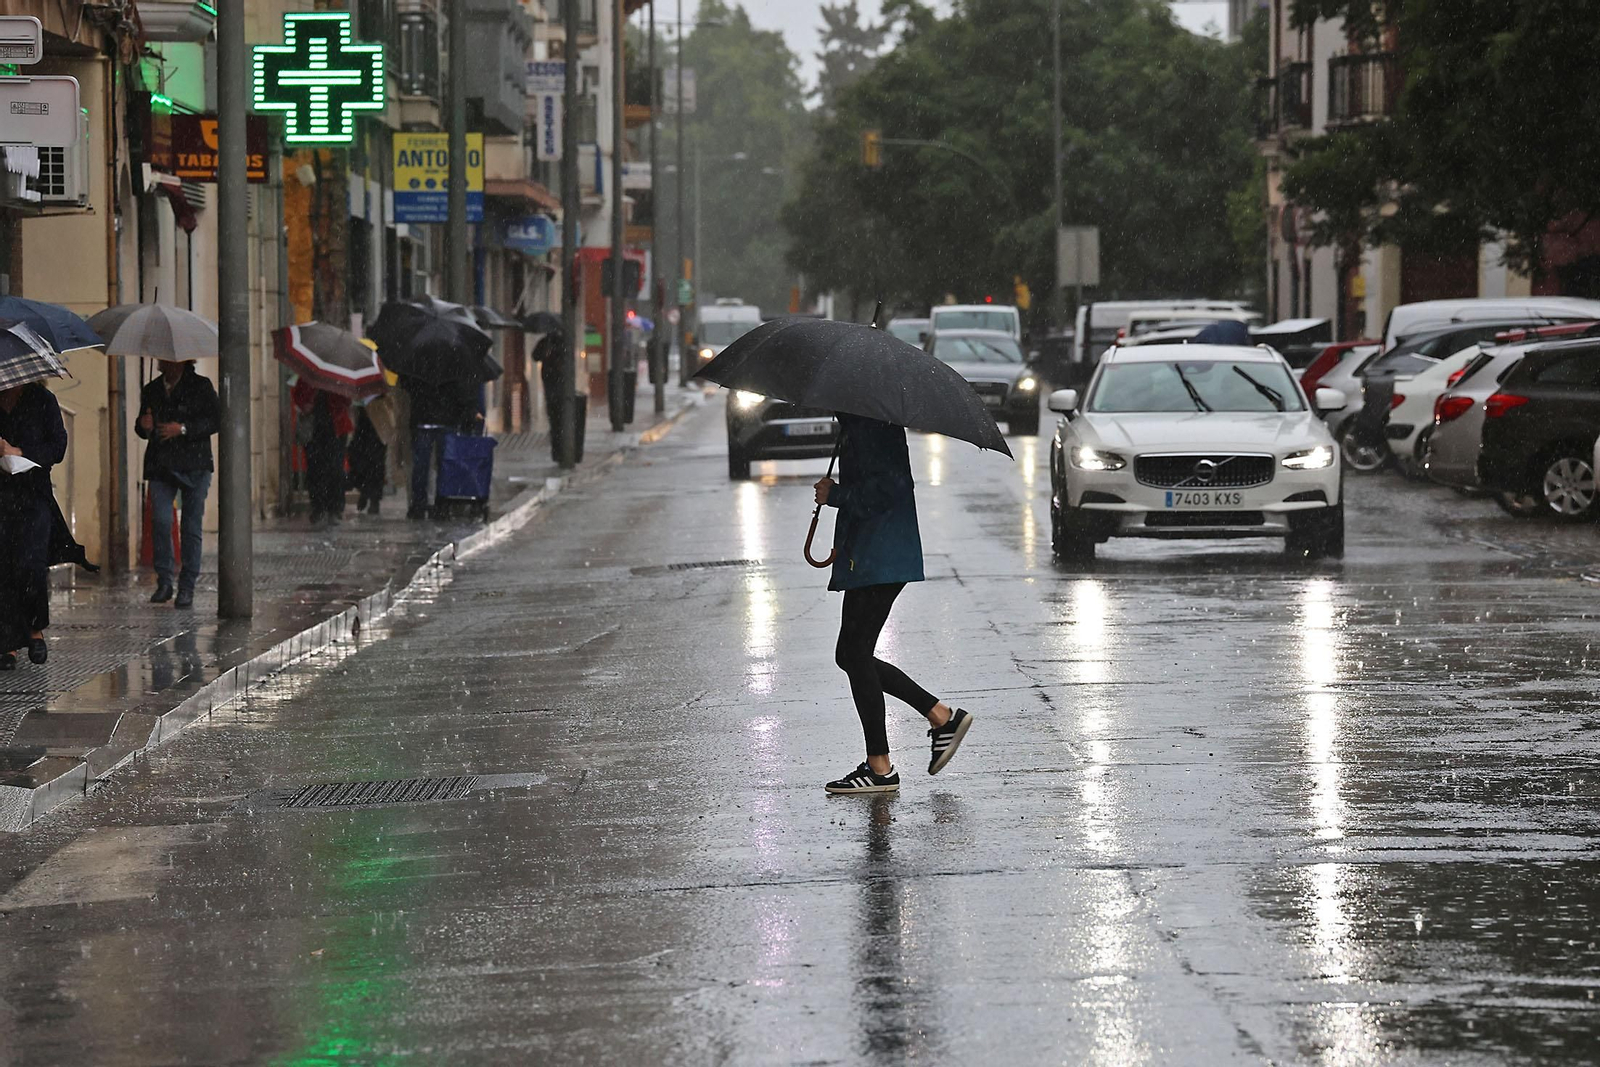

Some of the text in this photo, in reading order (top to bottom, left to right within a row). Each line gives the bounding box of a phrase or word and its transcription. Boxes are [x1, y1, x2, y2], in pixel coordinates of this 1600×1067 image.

[397, 149, 480, 168] ANTOO
[1175, 493, 1241, 506] 7403 KXS
